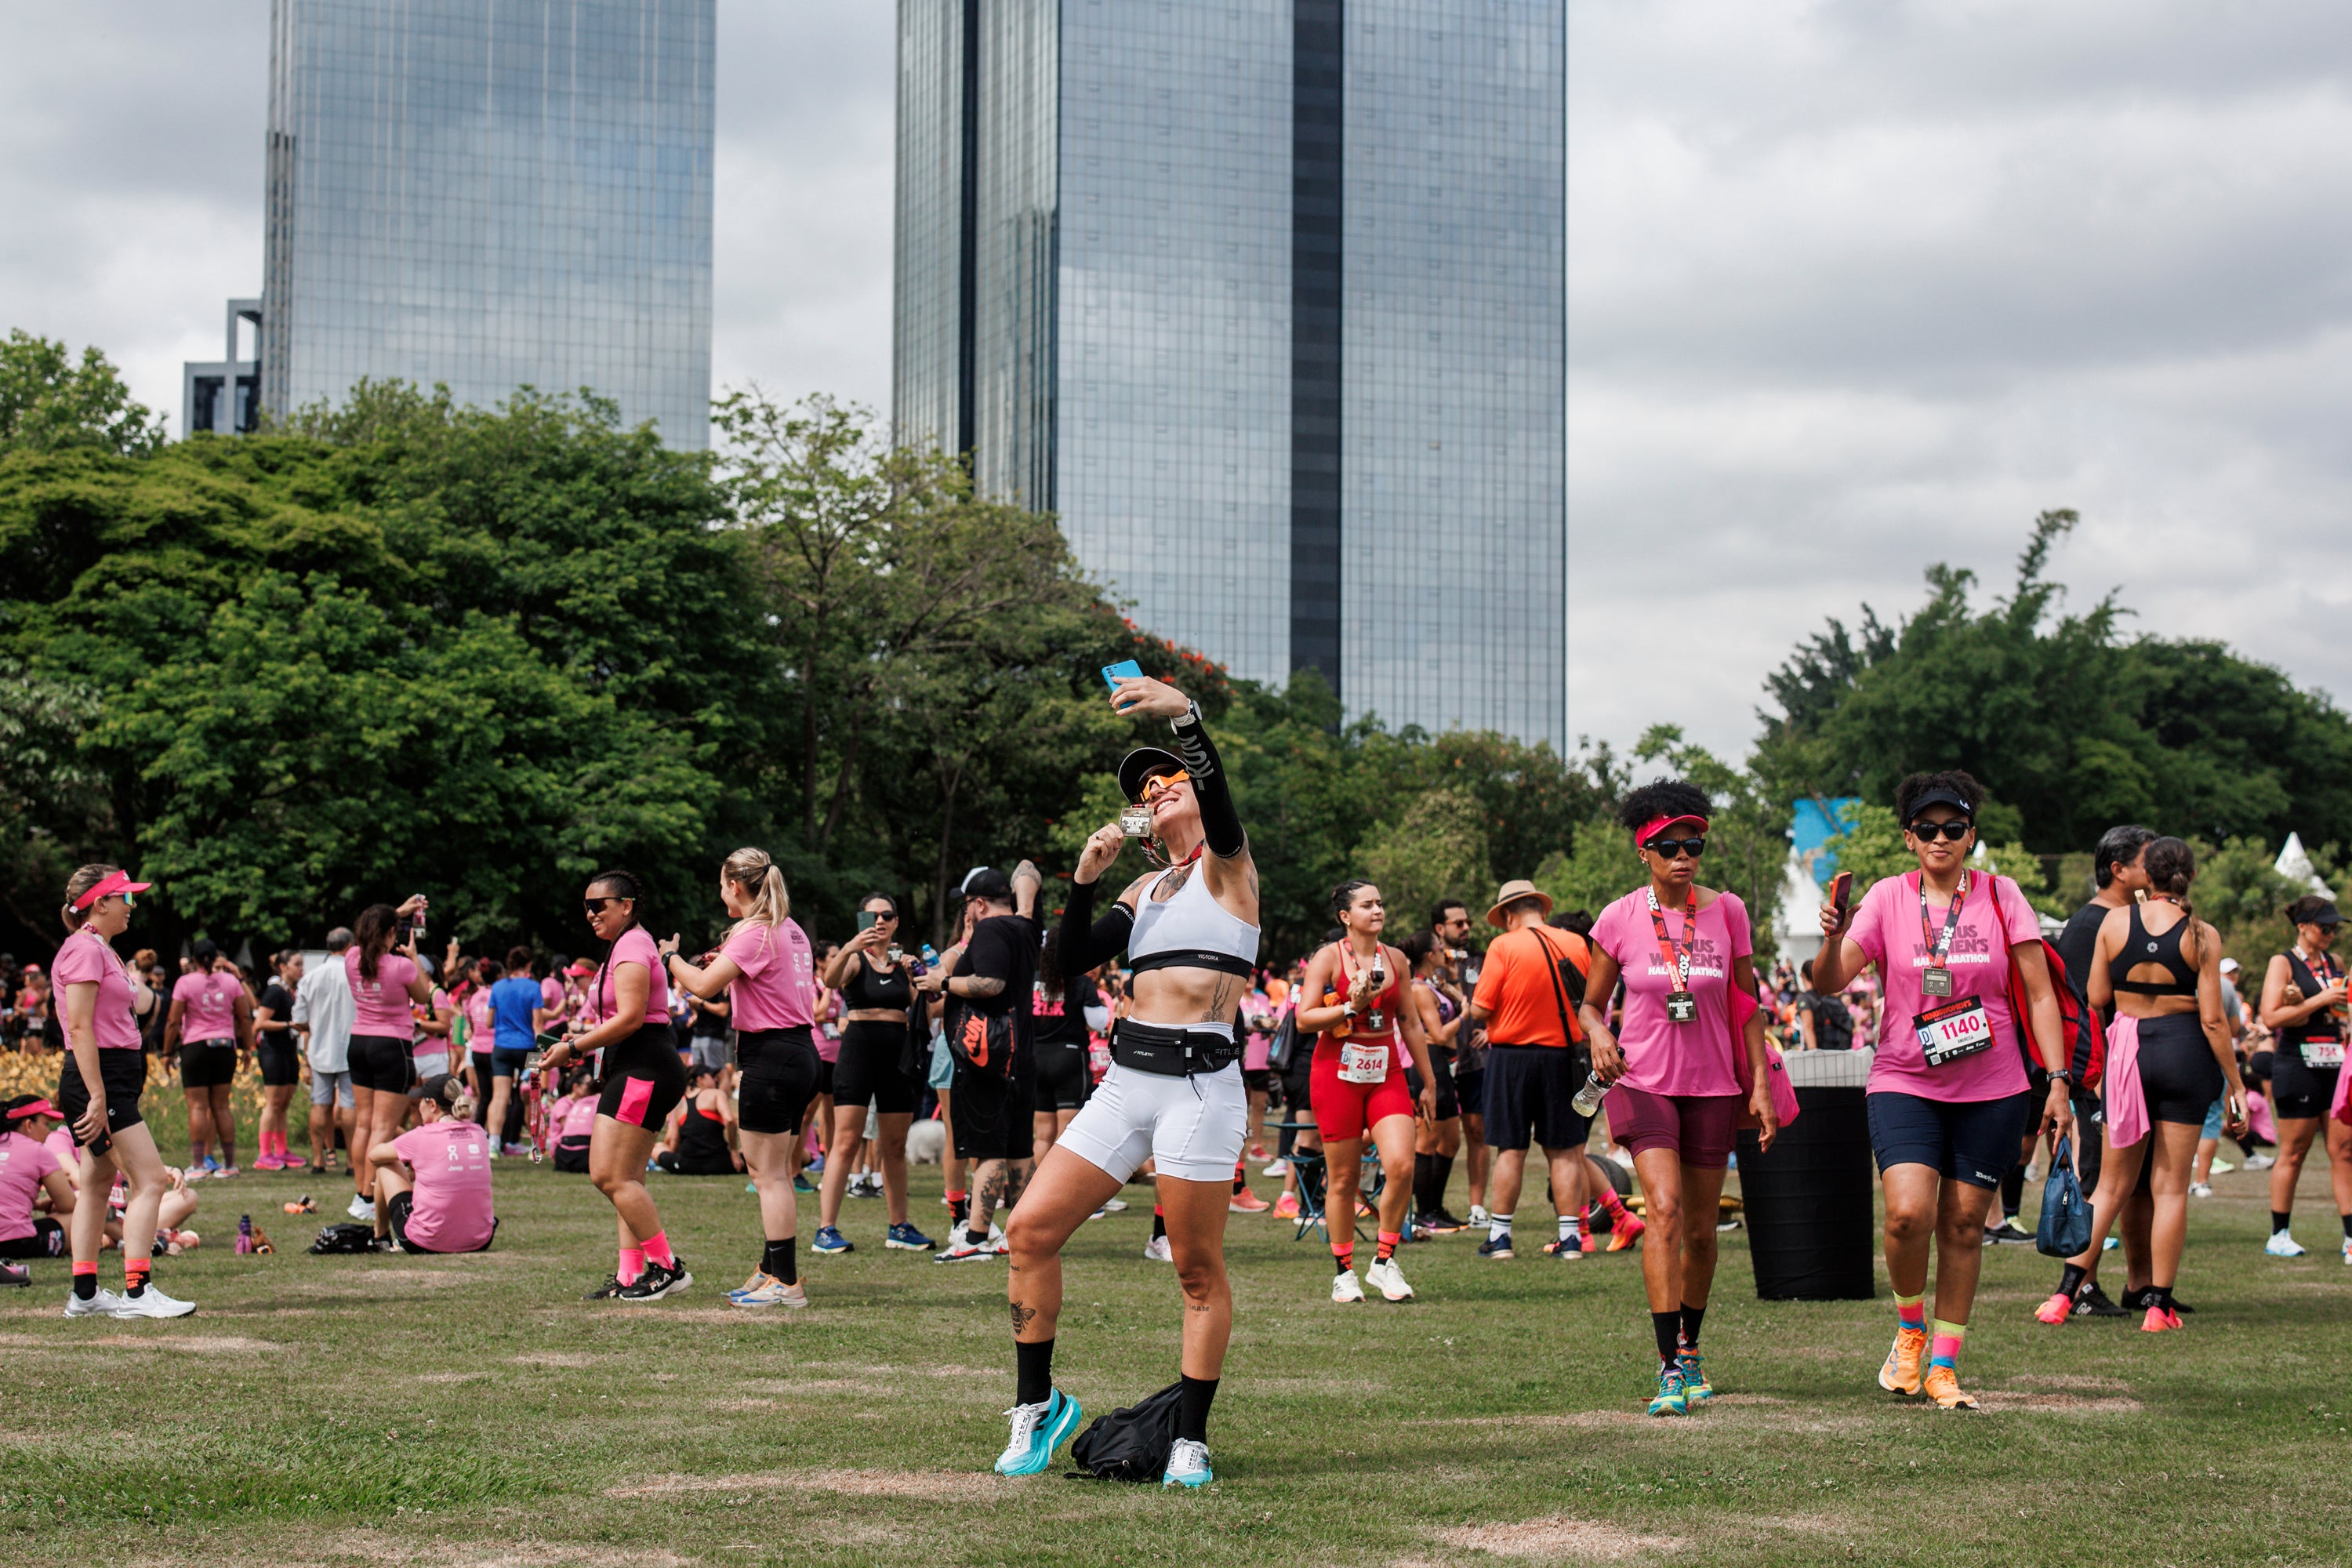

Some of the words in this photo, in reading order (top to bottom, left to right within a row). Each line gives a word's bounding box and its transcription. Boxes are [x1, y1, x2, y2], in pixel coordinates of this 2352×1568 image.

[1686, 903, 1696, 920] 15K
[962, 1014, 985, 1054] RUN
[1940, 1015, 1980, 1040] 1140
[1922, 1030, 1929, 1044] D
[1356, 1058, 1382, 1071] 2614
[649, 1272, 671, 1291] FILA
